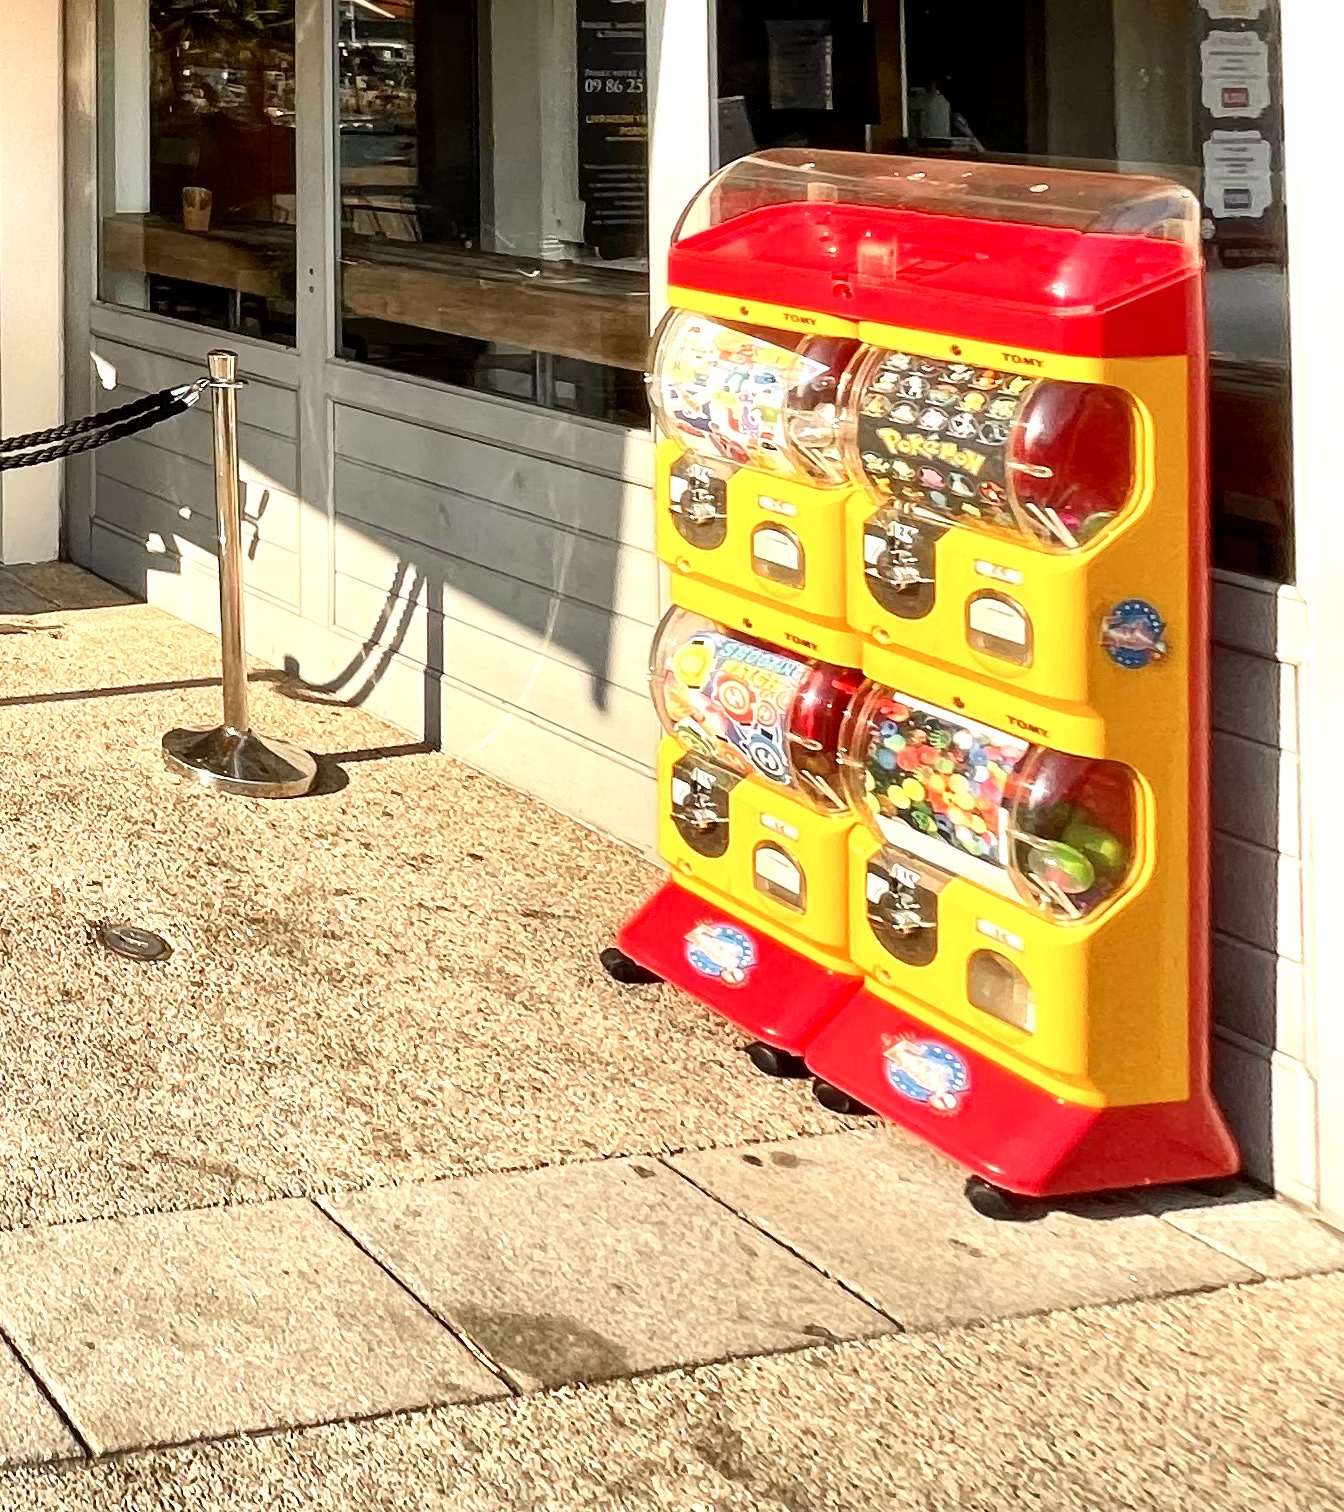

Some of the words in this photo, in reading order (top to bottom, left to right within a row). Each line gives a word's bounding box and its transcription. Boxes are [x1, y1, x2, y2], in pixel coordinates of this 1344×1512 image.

[584, 78, 602, 93] 09
[605, 78, 623, 93] 86
[626, 78, 644, 93] 25
[784, 313, 817, 326] TOMY
[1002, 353, 1044, 368] TOMY
[784, 632, 818, 651] TOMY
[1005, 714, 1049, 738] TOMY
